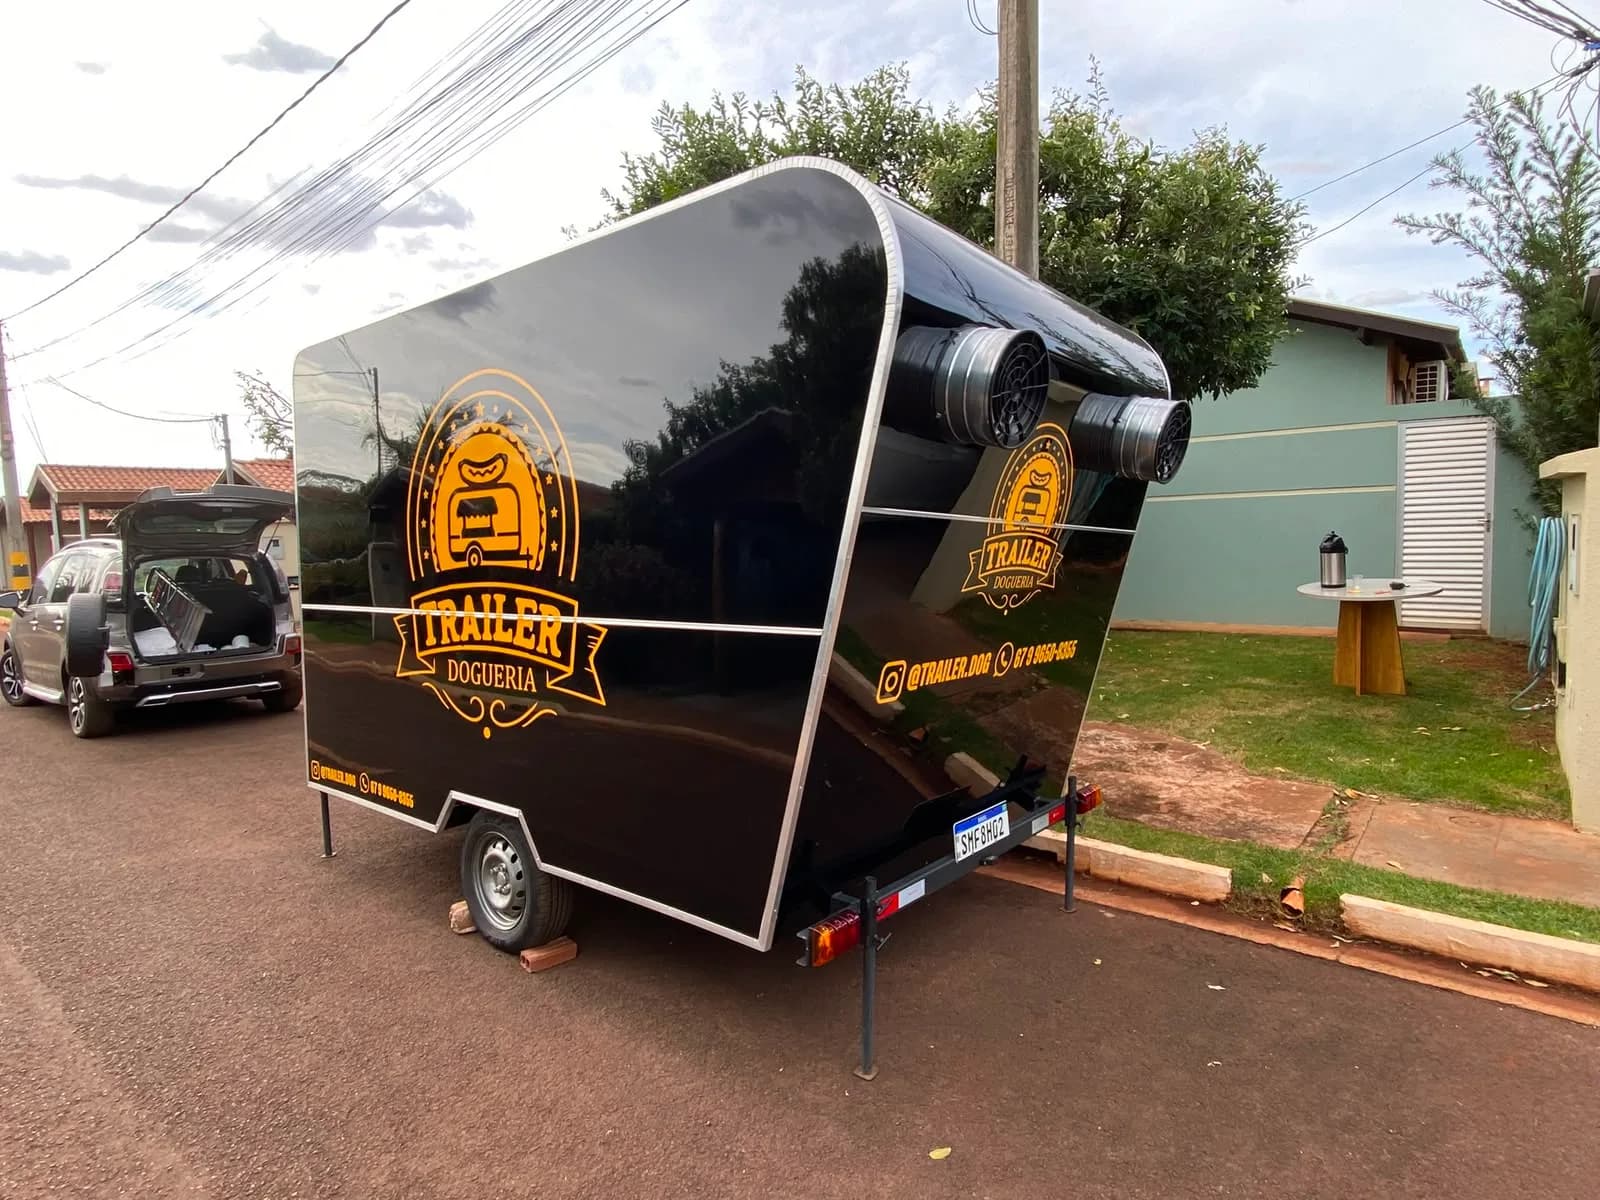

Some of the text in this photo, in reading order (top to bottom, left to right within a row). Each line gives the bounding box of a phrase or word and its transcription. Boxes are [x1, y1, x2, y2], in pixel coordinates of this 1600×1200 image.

[985, 538, 1052, 570] TRAILER
[993, 575, 1034, 589] DOGUERIA
[419, 593, 562, 658] TRAILER
[447, 658, 537, 693] DOGUERIA
[906, 652, 993, 692] @TRAILER.DOG
[1013, 646, 1029, 669] 67
